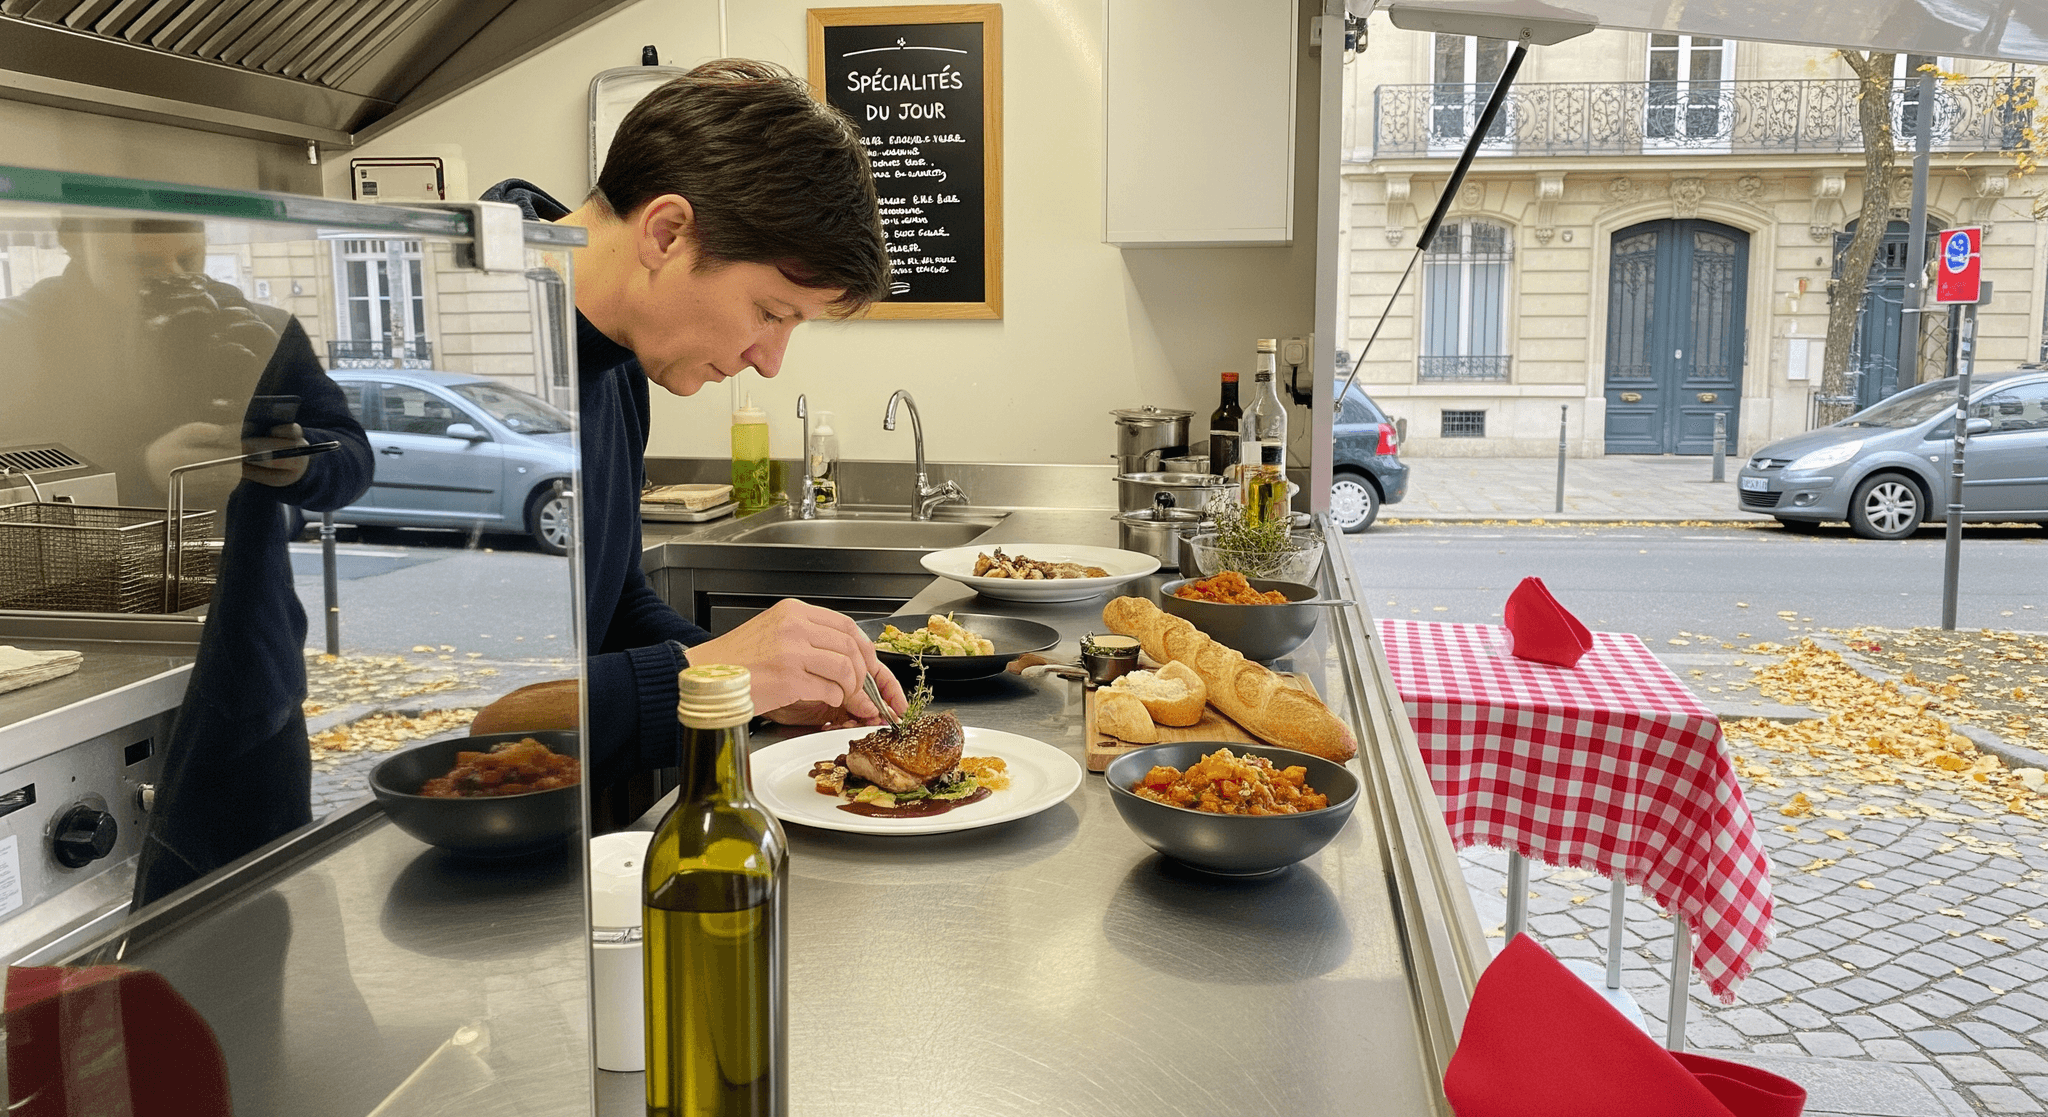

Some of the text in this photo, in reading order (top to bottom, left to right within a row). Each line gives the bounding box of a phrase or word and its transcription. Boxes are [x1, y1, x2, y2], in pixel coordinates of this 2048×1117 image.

[846, 64, 963, 94] SPÉCIALITÉS
[866, 102, 946, 121] DU JOUR
